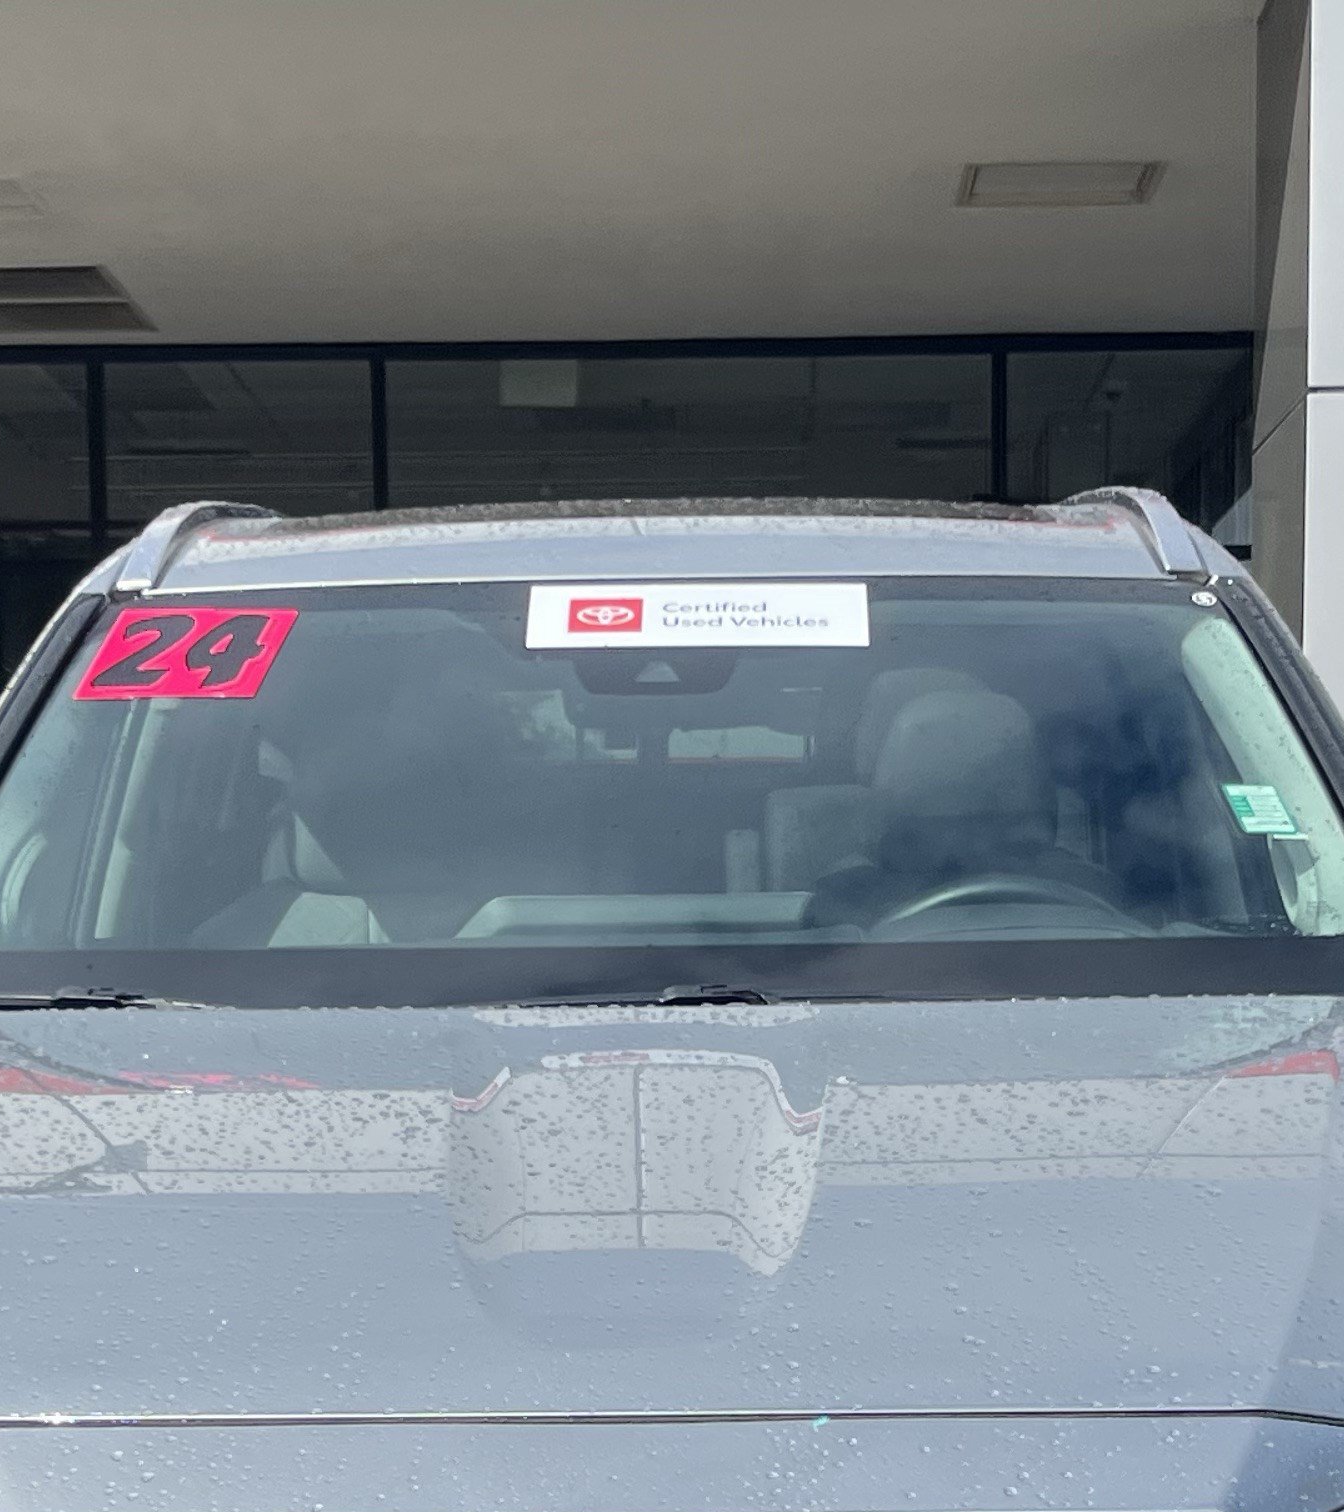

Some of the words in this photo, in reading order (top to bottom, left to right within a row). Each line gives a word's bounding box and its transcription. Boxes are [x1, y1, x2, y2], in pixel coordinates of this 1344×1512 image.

[662, 601, 767, 614] Certified
[662, 616, 724, 627] Used
[730, 615, 829, 627] Vehicles
[90, 614, 267, 688] 24
